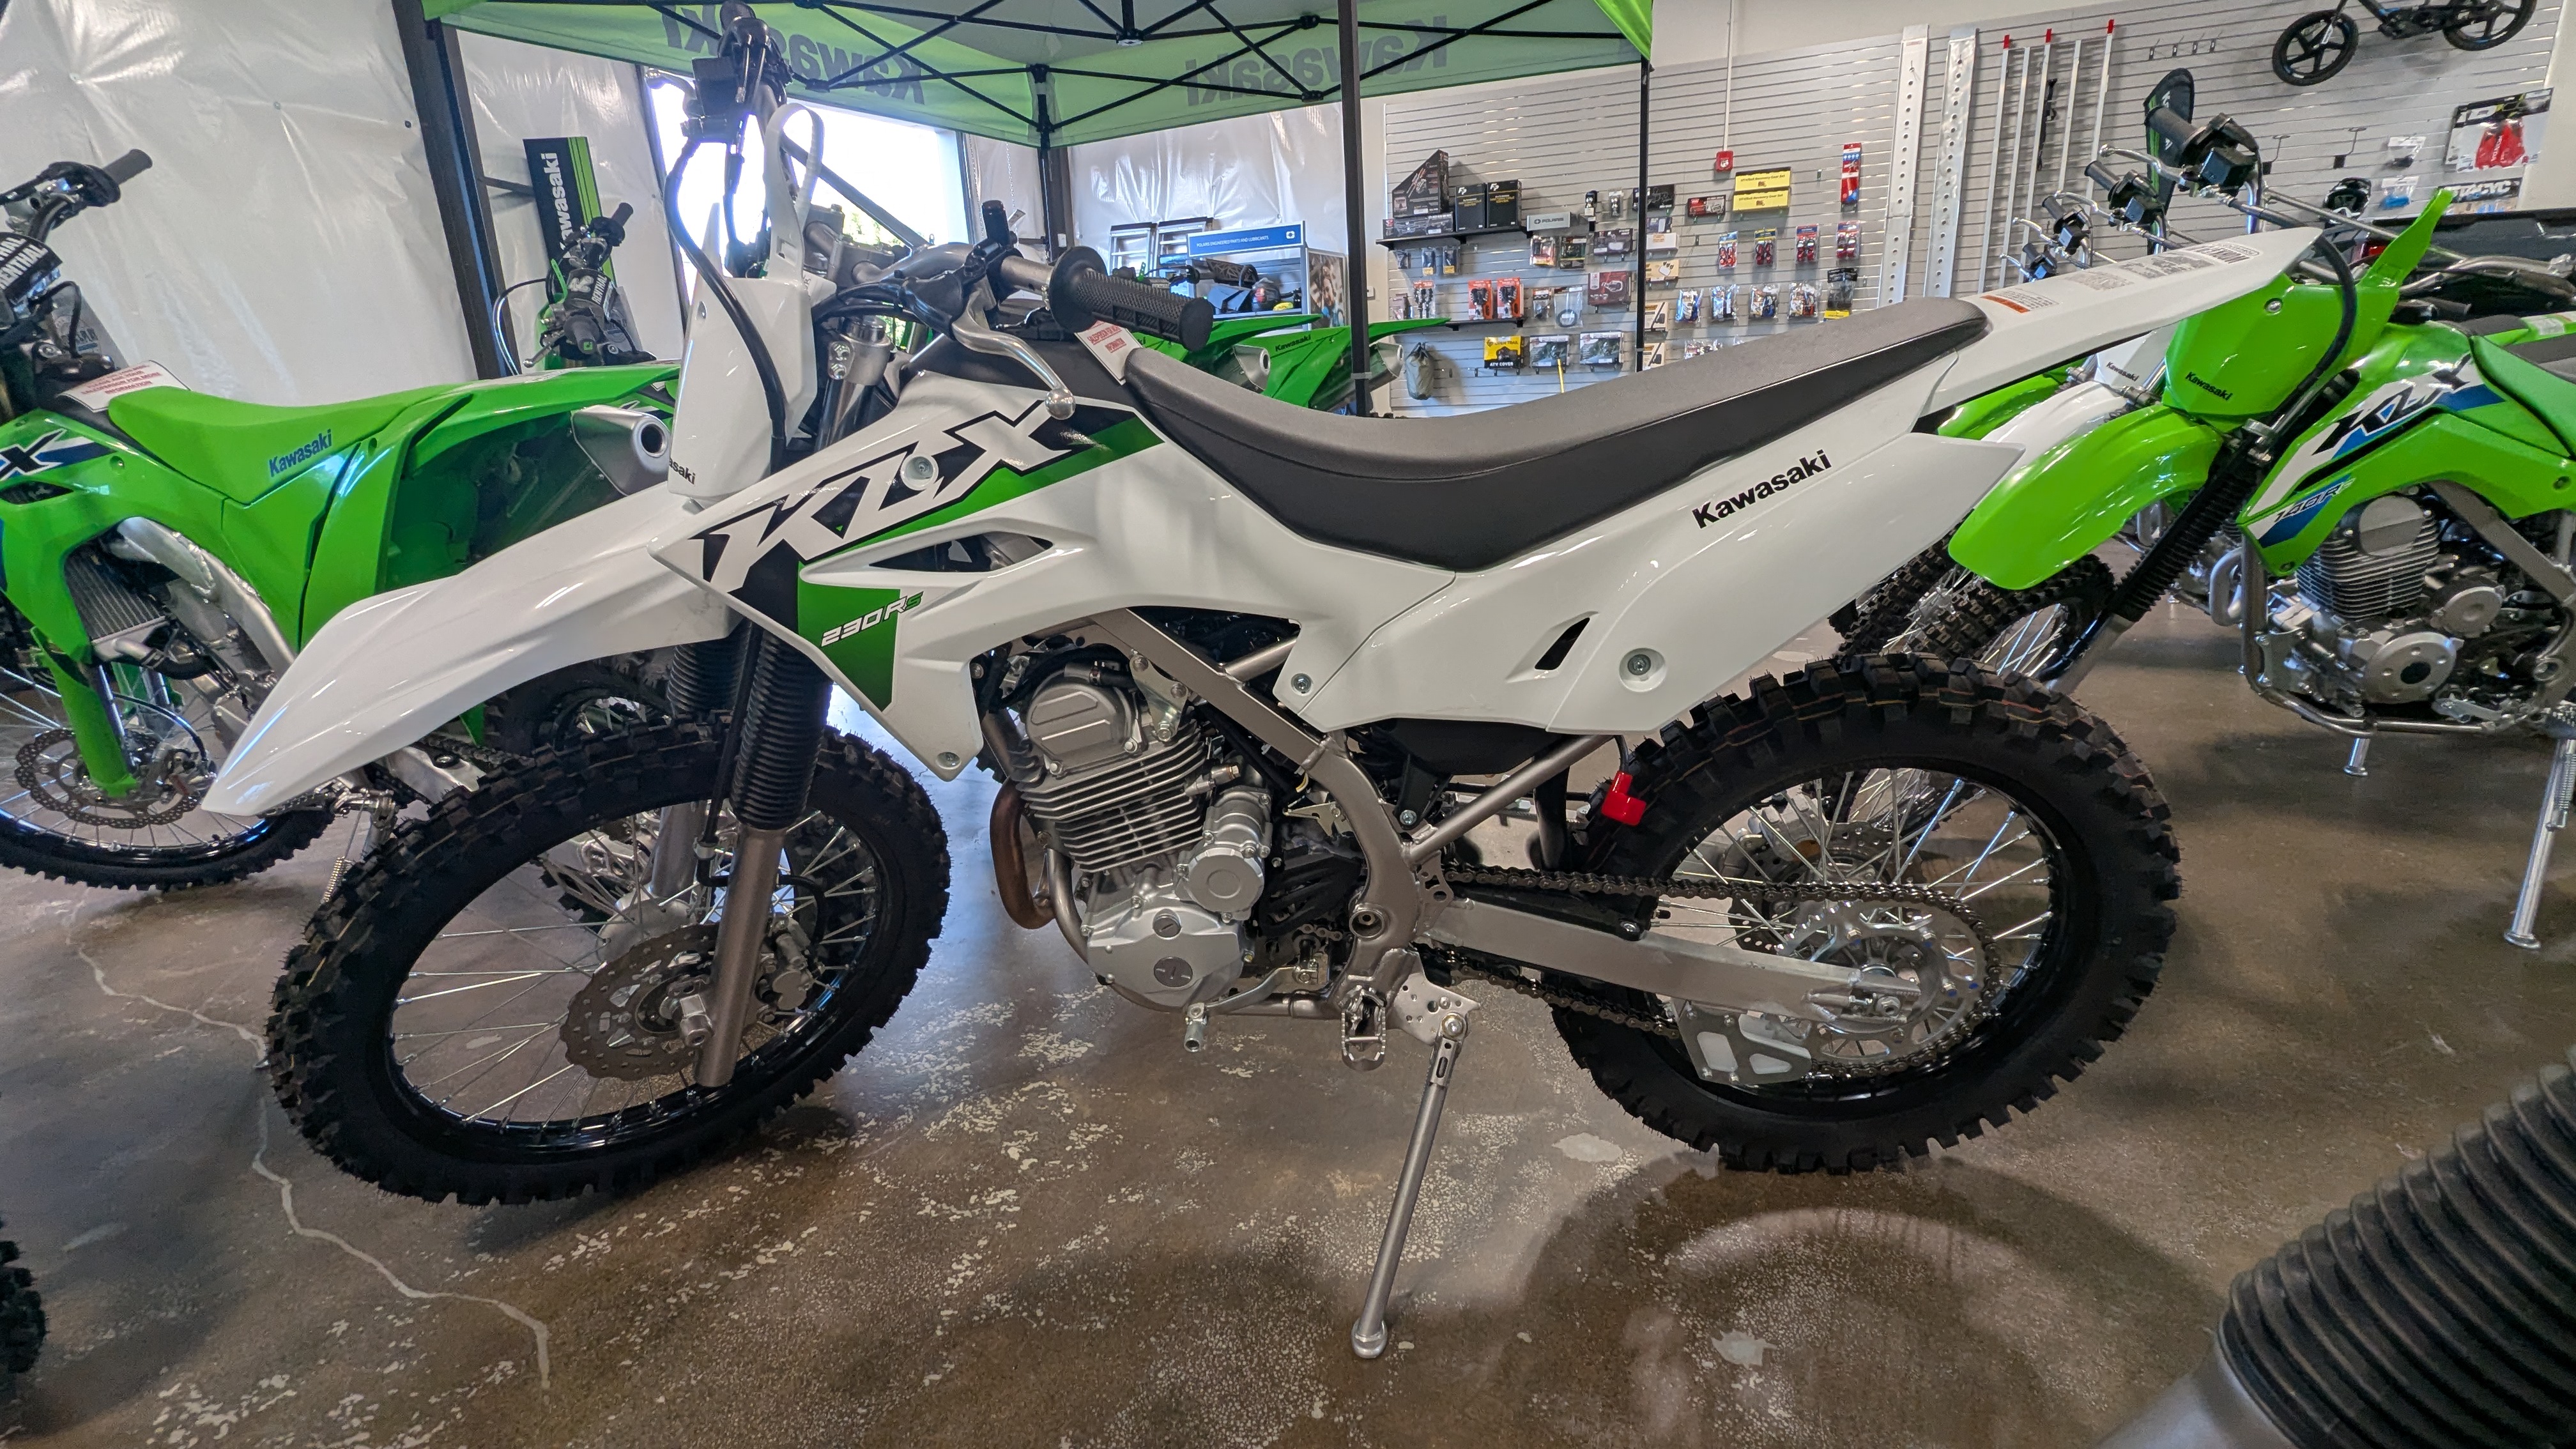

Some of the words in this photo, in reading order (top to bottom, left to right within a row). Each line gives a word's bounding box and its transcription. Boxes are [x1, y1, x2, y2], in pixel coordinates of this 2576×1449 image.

[592, 274, 607, 304] RENTHAL
[1275, 334, 1311, 352] Kawasaki
[2106, 362, 2139, 382] Kawasaki
[2185, 371, 2233, 401] Kawasaki
[269, 429, 332, 477] Kawasaki
[669, 457, 696, 485] asaki
[689, 399, 1078, 592] KLX
[1692, 449, 1832, 529] Kawasaki
